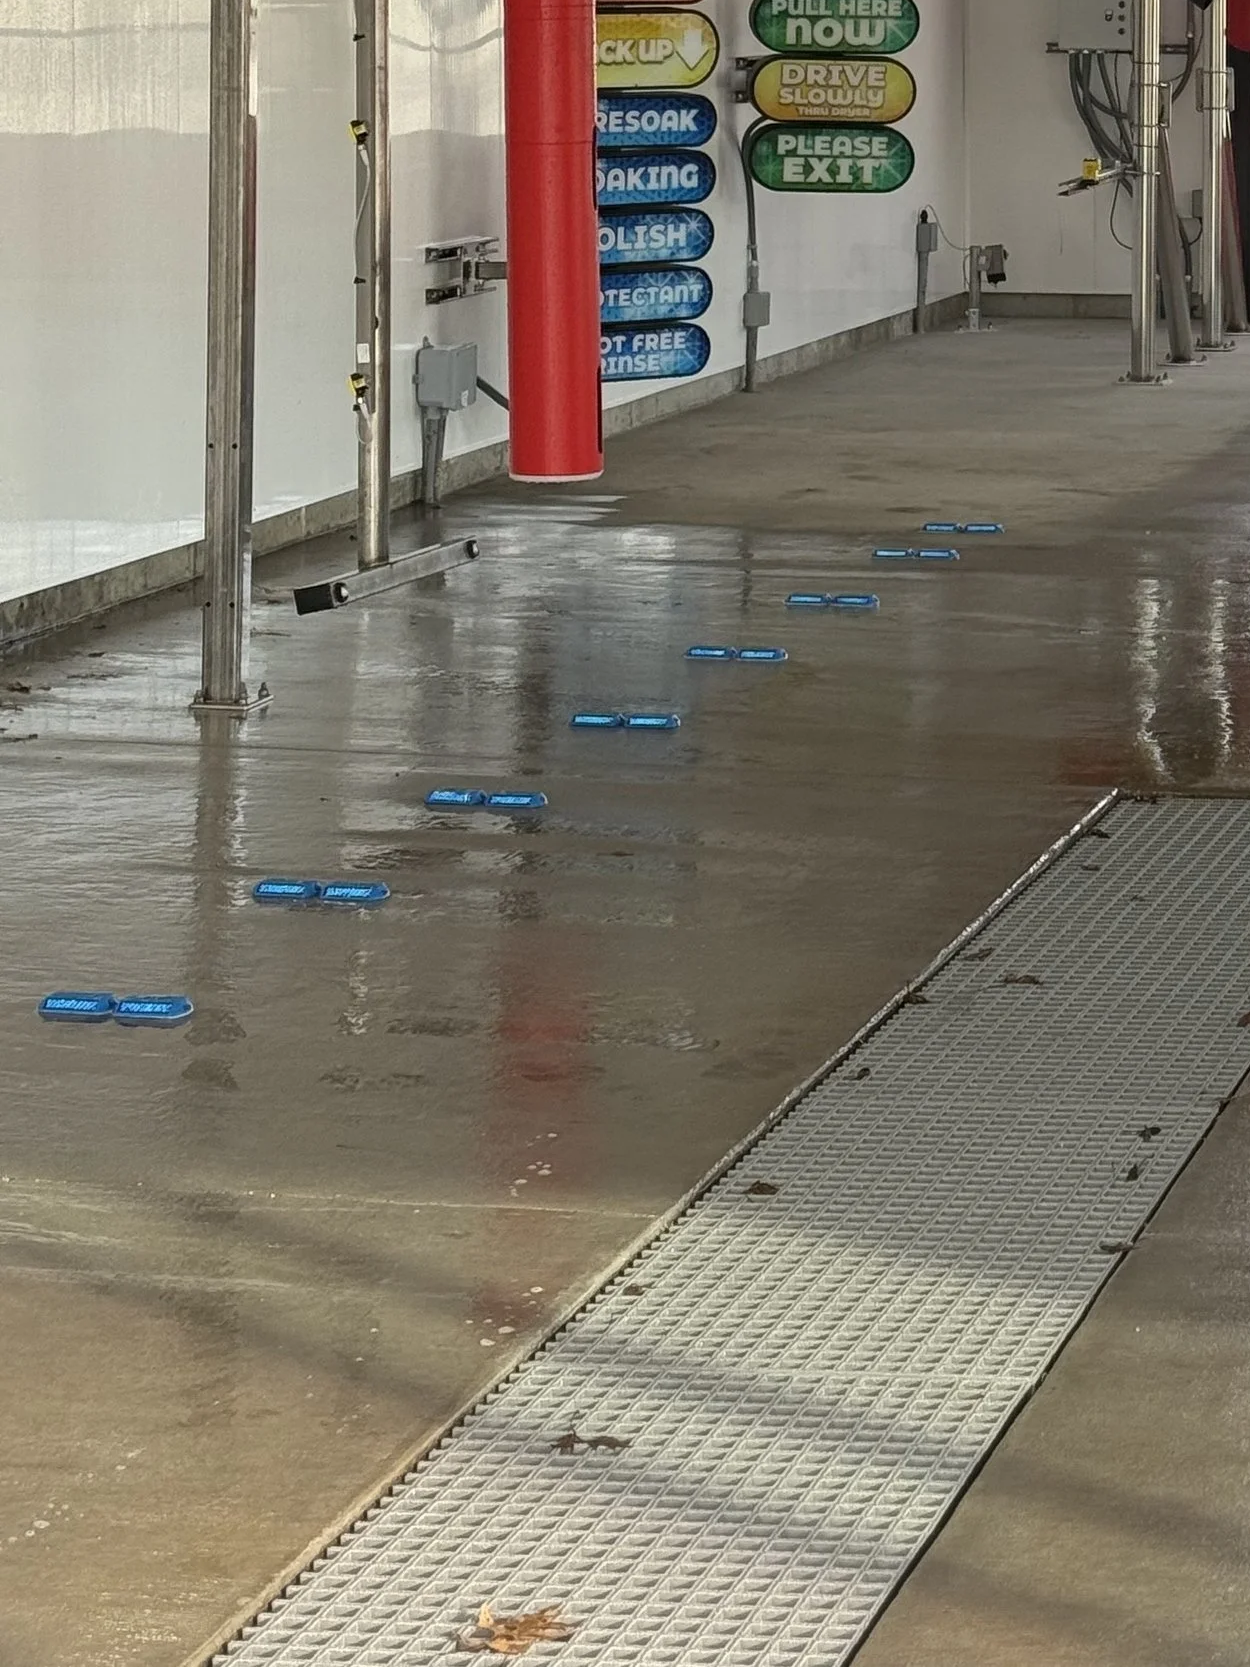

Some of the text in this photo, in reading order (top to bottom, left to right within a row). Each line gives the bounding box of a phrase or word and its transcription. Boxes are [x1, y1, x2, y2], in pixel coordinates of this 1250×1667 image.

[839, 0, 902, 17] HERE
[596, 38, 674, 63] CK UP
[781, 63, 886, 87] DRIVE
[779, 87, 885, 108] SLOWLY
[595, 109, 699, 133] RESOAK
[799, 106, 829, 116] THRU
[777, 135, 889, 157] PLEASE
[596, 163, 699, 192] AKING
[783, 157, 882, 184] EXIT
[598, 222, 687, 251] OLISH
[600, 284, 703, 307] TECTANT
[600, 331, 687, 355] OT FREE
[600, 354, 660, 375] INSE
